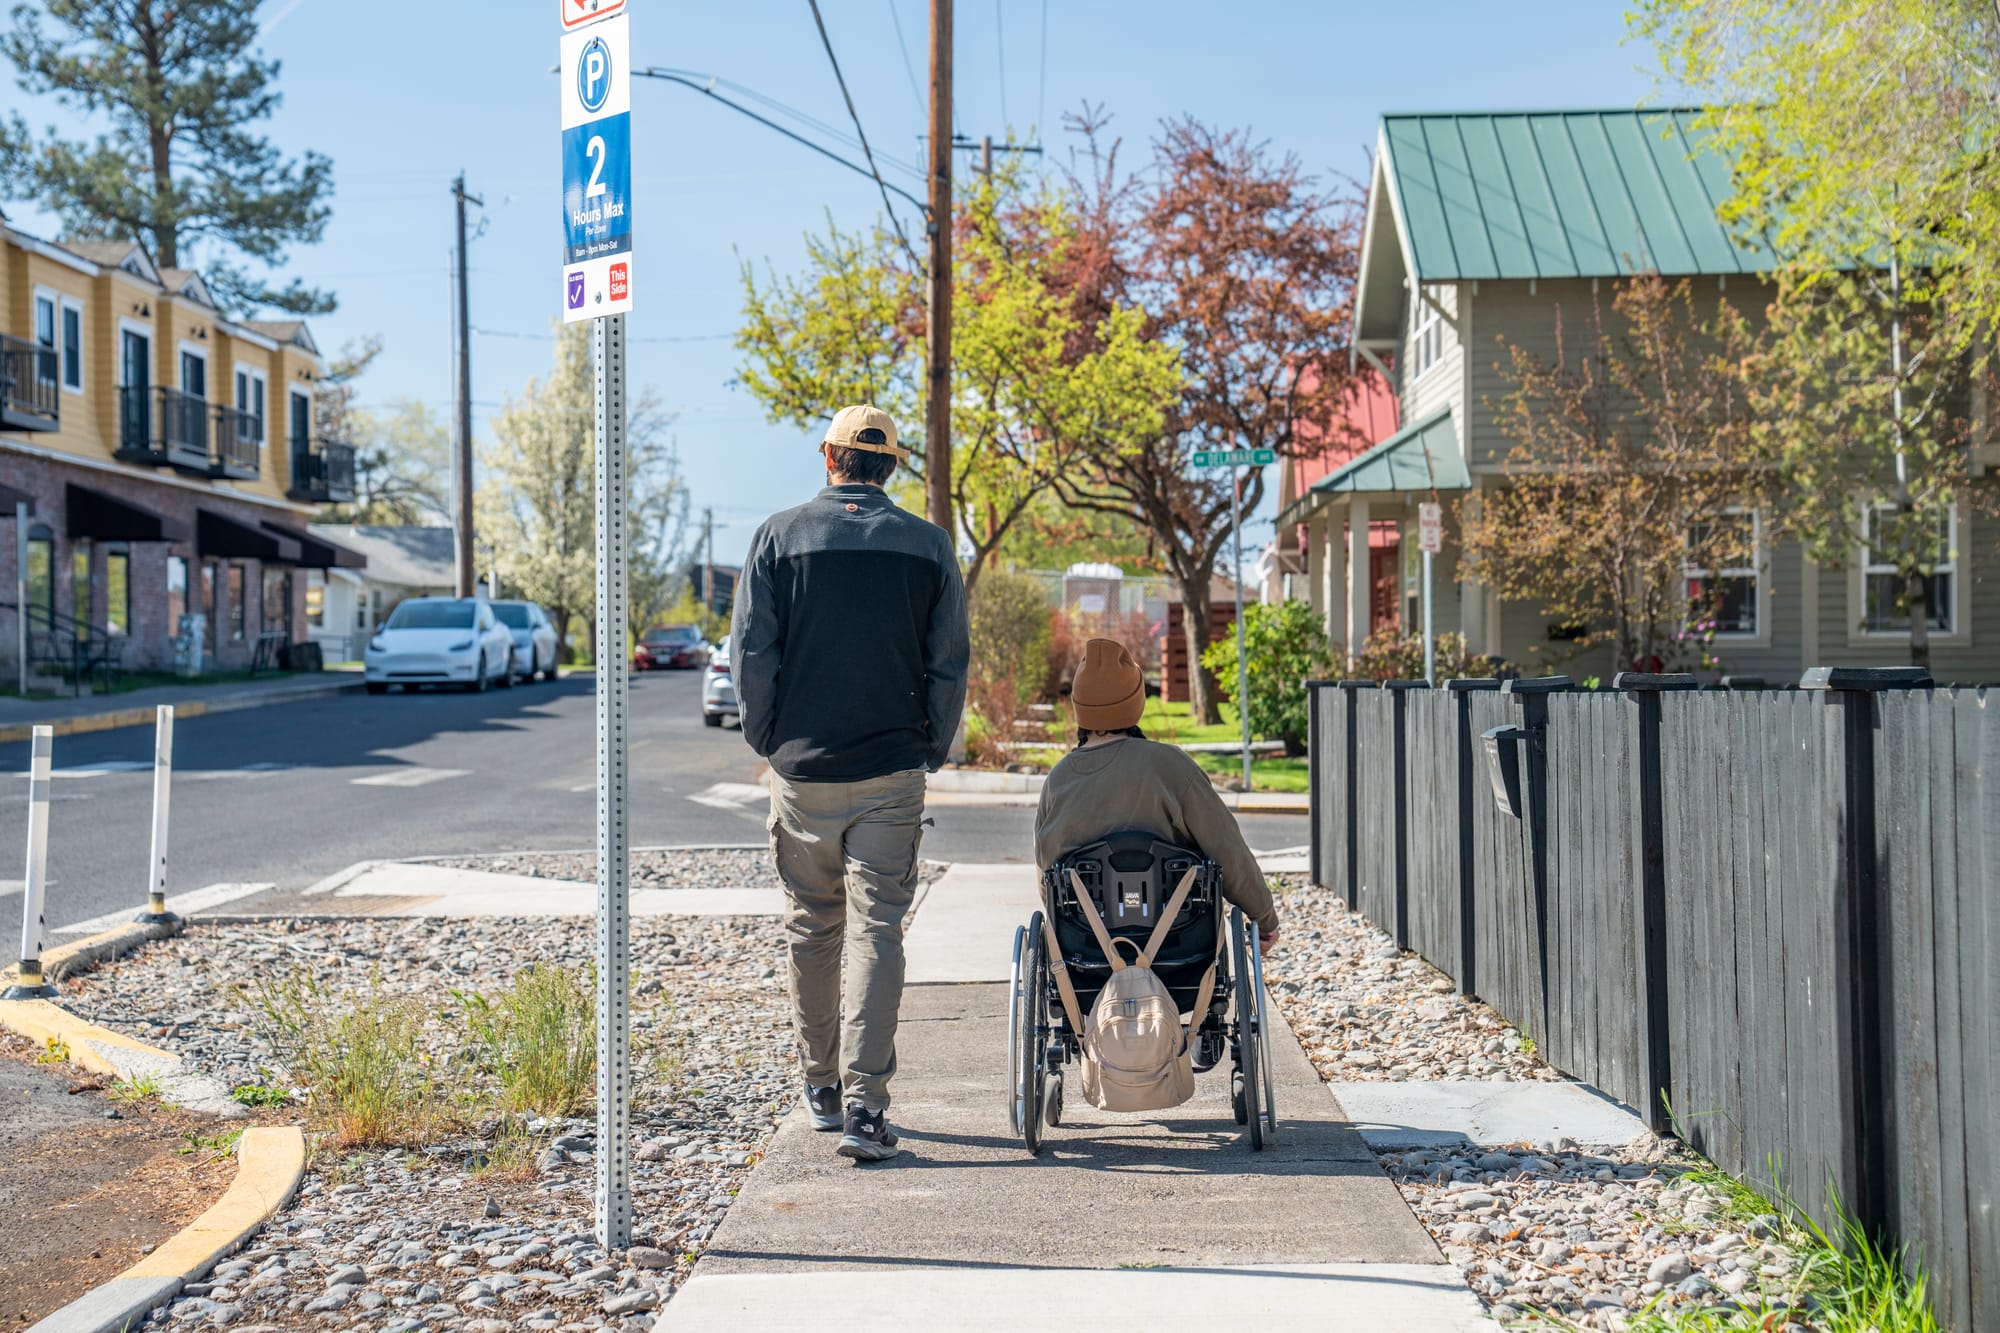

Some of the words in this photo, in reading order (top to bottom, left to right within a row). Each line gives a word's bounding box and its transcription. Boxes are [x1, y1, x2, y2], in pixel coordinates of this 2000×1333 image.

[587, 51, 604, 99] P
[586, 135, 606, 198] 2
[573, 210, 601, 226] Hours
[604, 203, 623, 218] Max
[586, 227, 595, 235] Per
[595, 225, 606, 233] Zone
[611, 270, 626, 282] This
[611, 283, 626, 295] Side
[1209, 450, 1254, 466] DELAWARE
